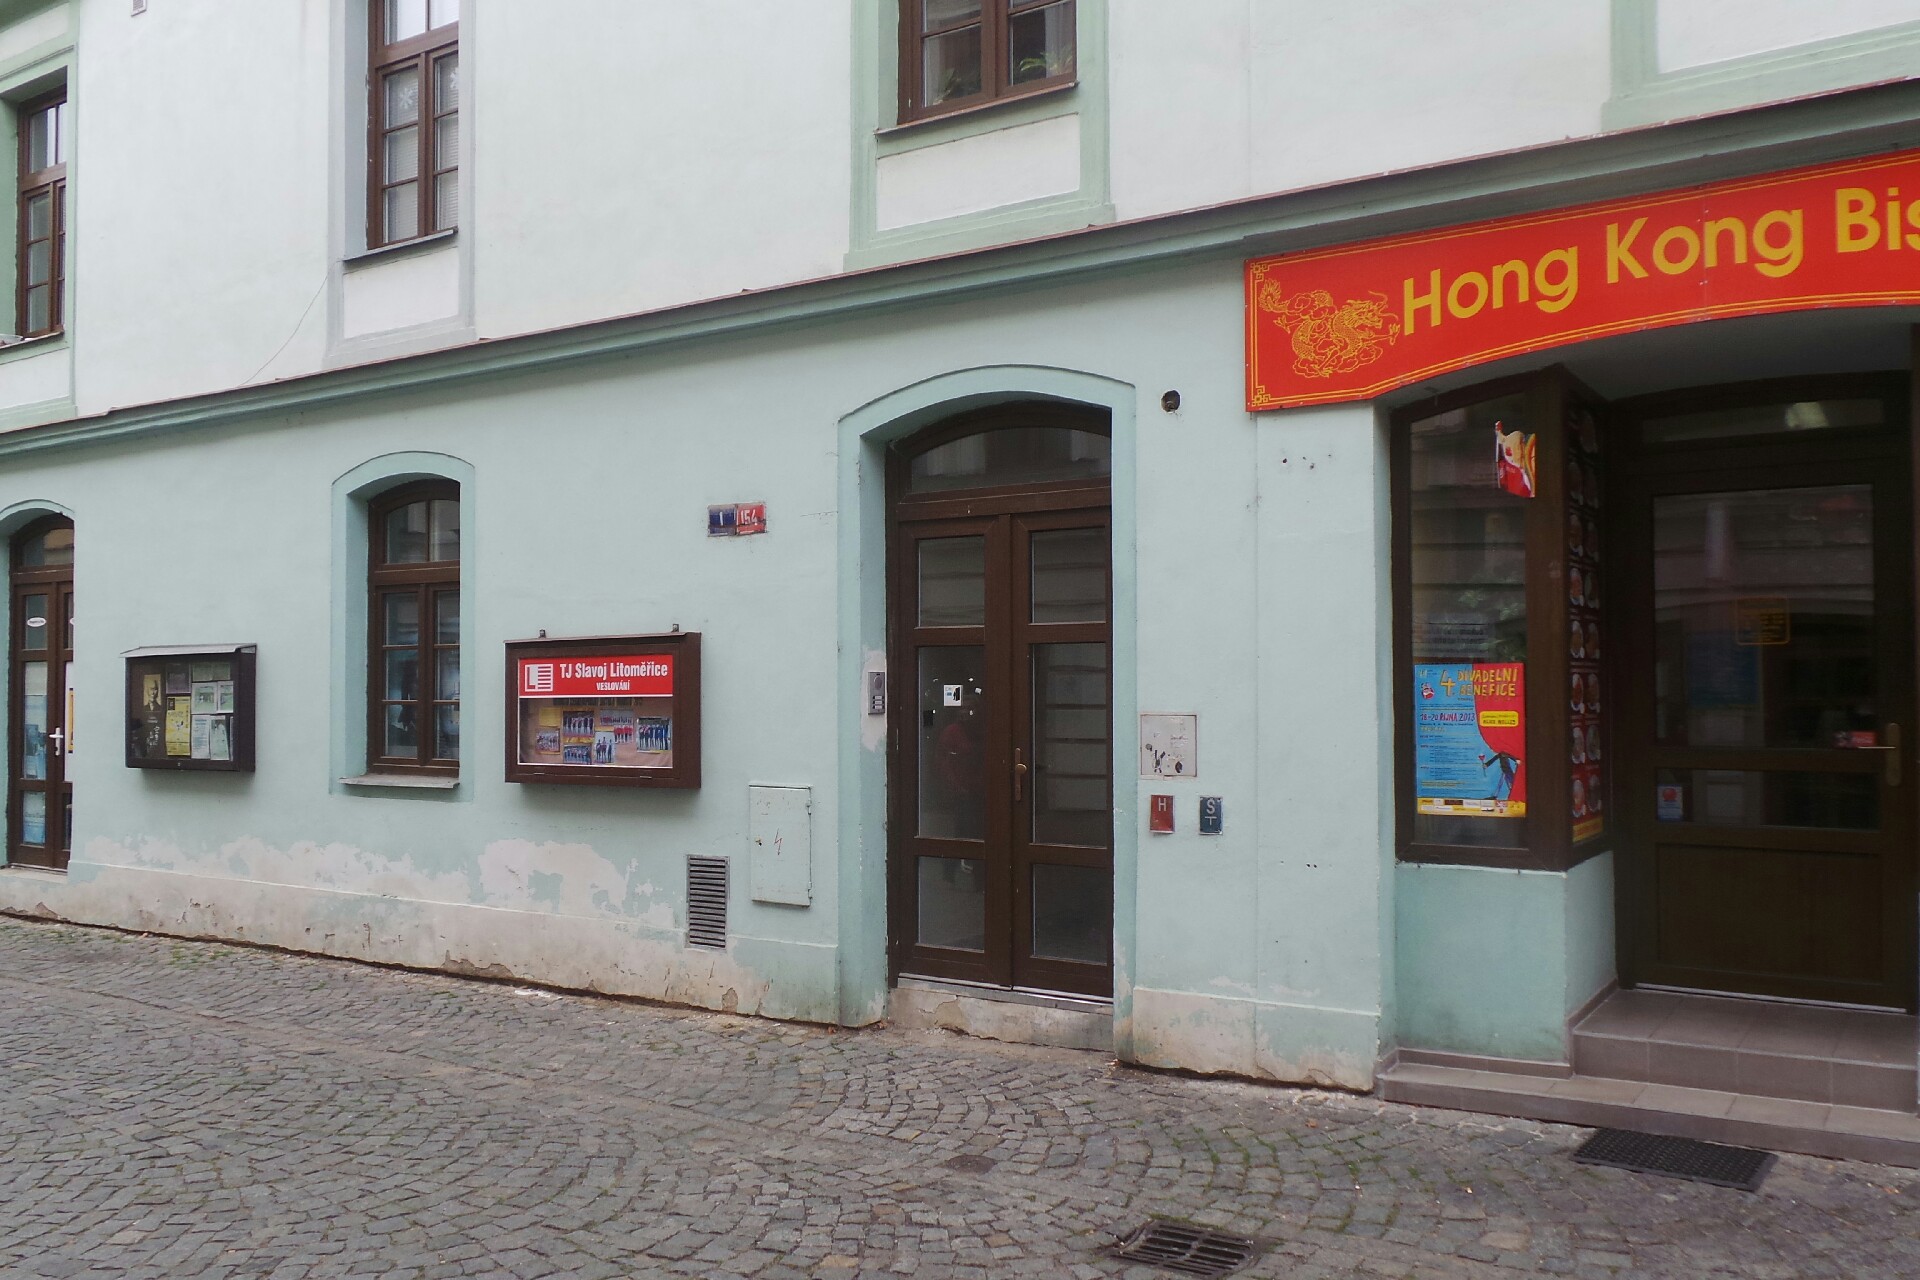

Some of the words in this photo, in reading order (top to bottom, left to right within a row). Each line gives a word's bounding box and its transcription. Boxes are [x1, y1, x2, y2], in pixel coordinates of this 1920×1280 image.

[1403, 244, 1579, 335] Hong
[1606, 208, 1804, 284] Kong
[740, 508, 758, 526] 154
[560, 663, 573, 679] TJ
[575, 661, 607, 681] Slavoj
[609, 660, 668, 678] Litoměřice
[596, 680, 631, 691] VESLOVÁNÍ
[1158, 797, 1167, 812] H
[1205, 816, 1217, 825] T
